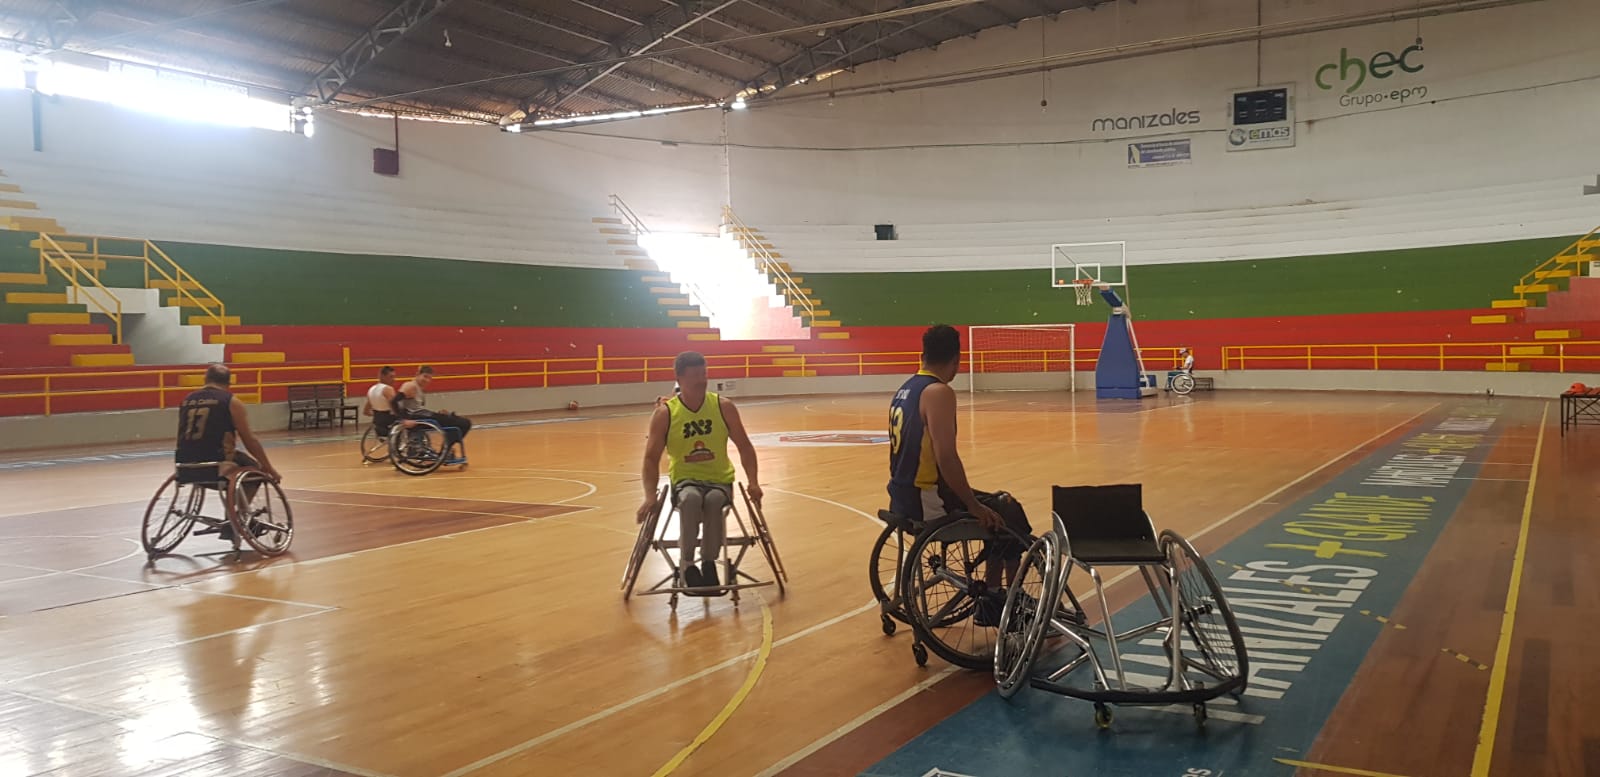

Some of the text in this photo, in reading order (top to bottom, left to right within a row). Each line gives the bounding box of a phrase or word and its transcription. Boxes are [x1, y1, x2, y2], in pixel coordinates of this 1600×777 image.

[1315, 45, 1424, 93] chec
[1092, 108, 1201, 132] manizales
[1250, 127, 1289, 140] emas
